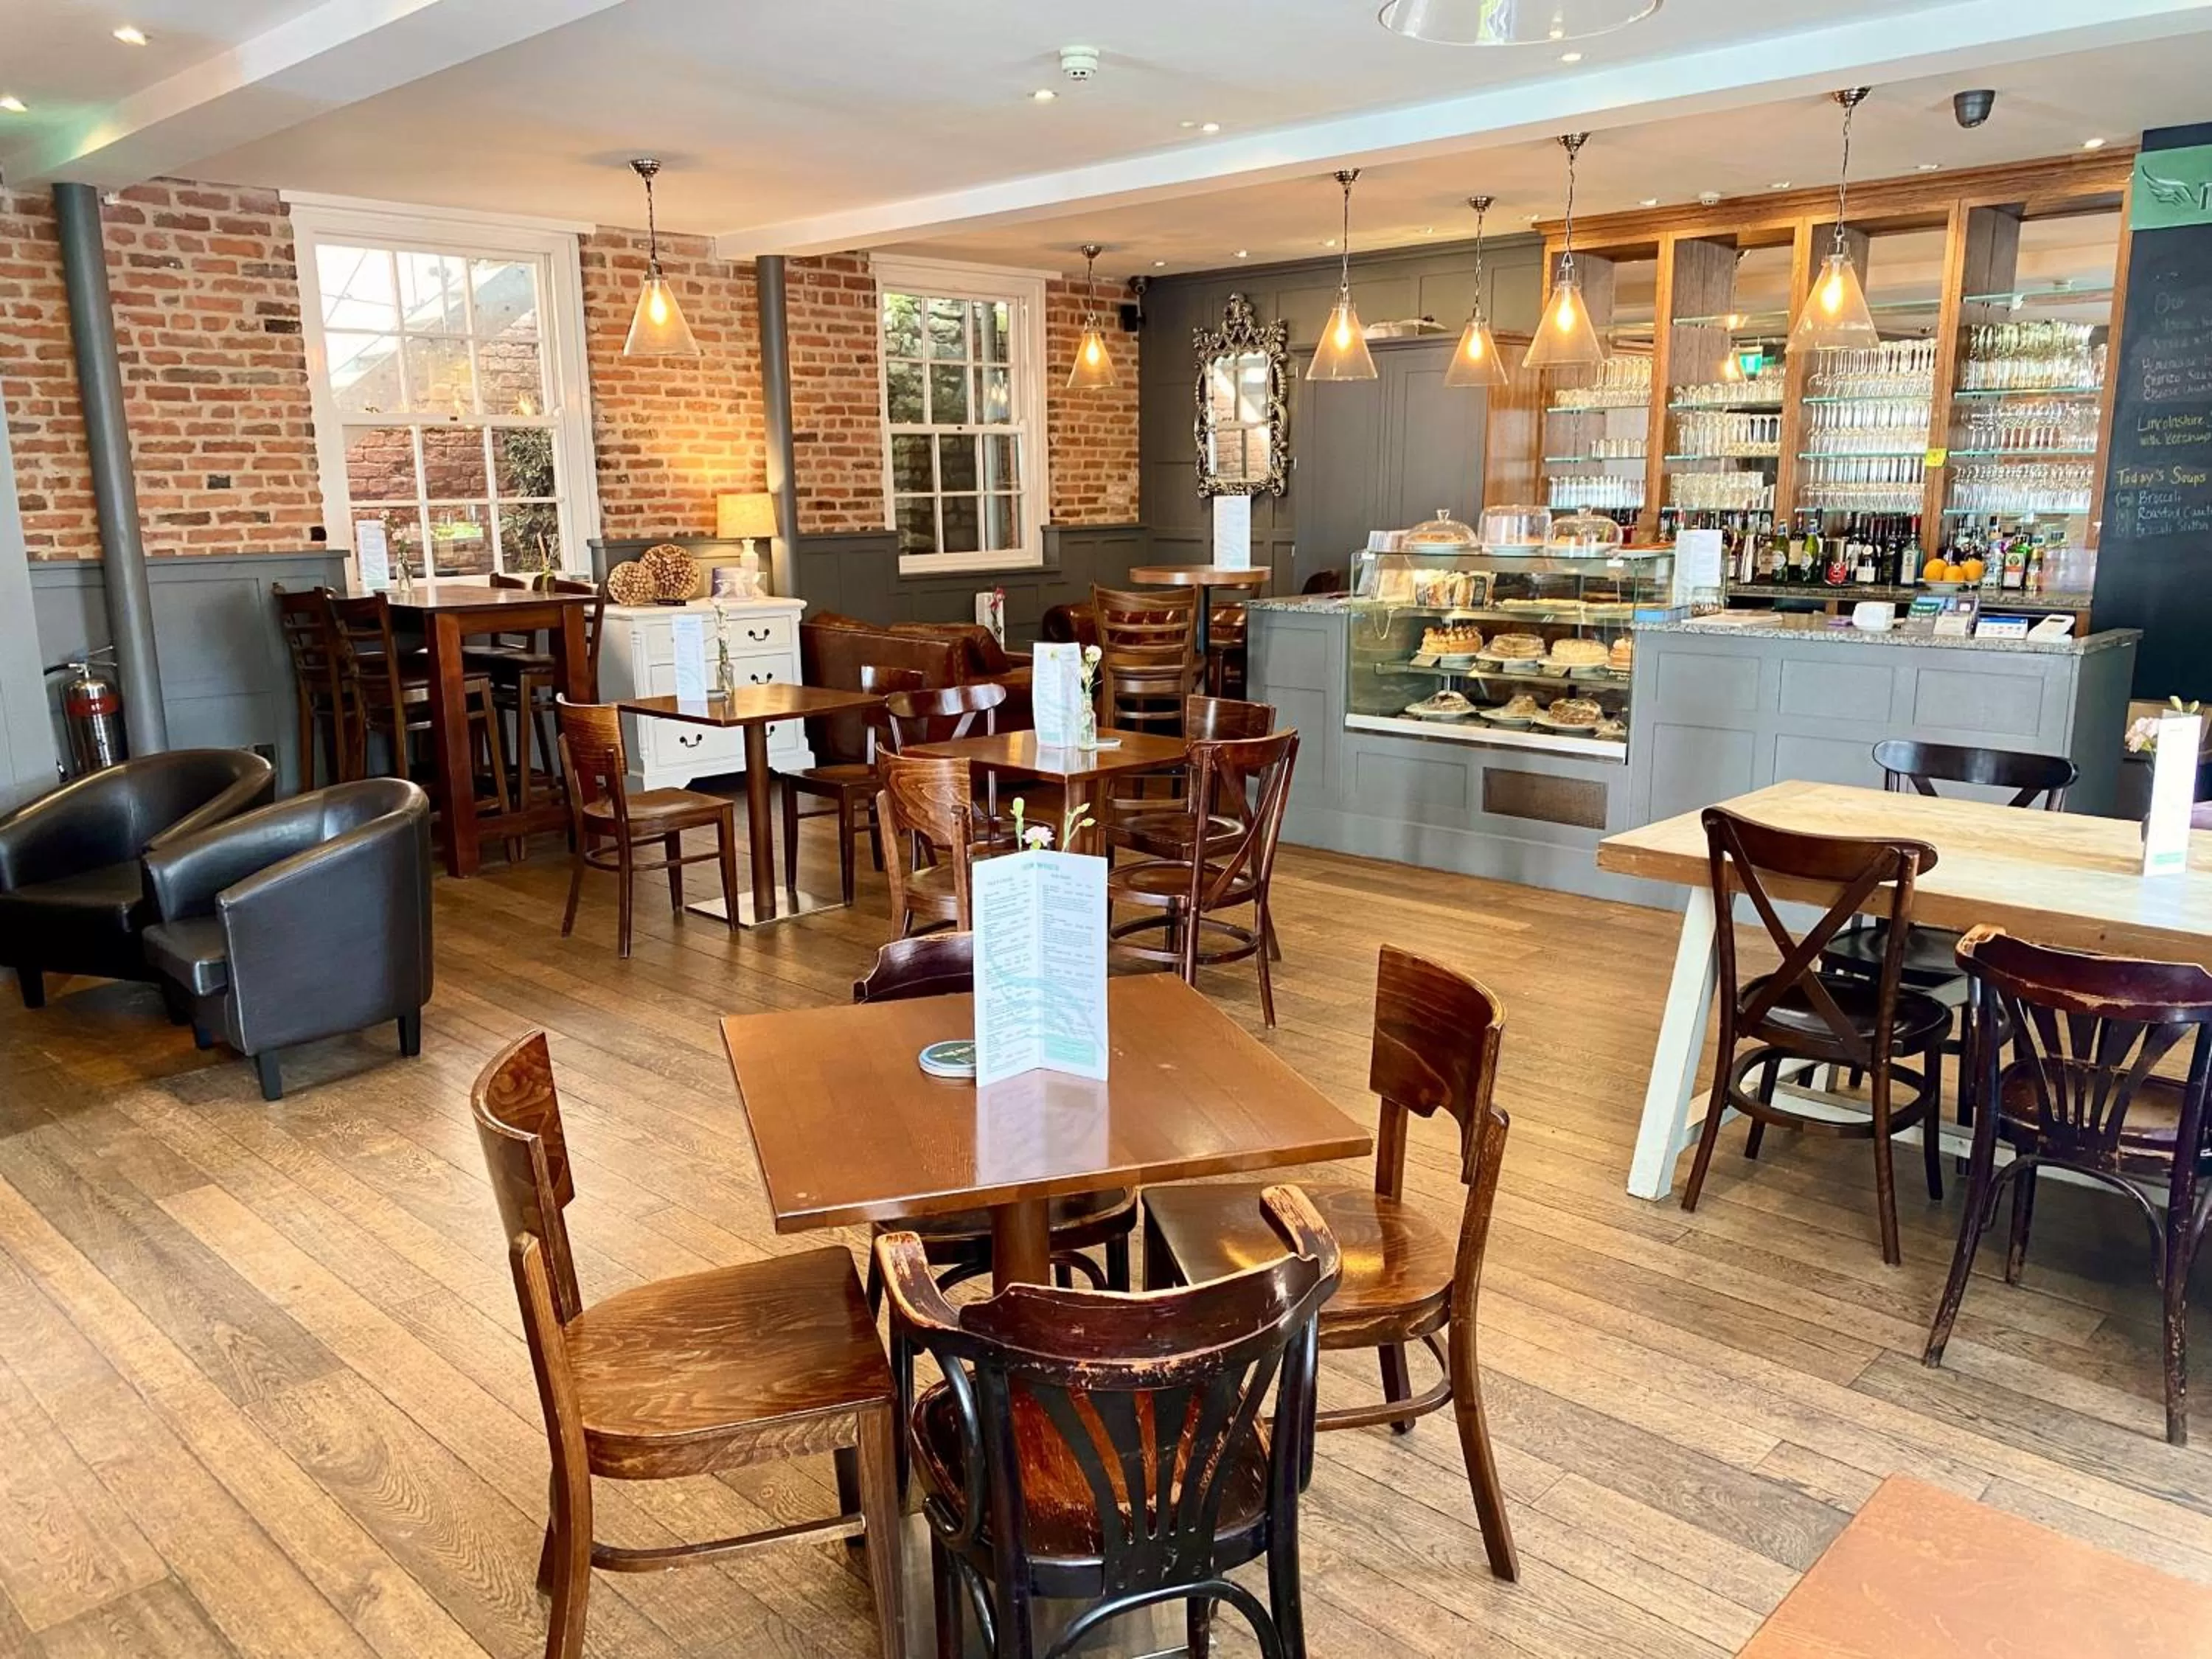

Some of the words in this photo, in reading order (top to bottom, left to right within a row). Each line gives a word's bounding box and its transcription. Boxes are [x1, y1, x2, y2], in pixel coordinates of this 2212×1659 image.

[2138, 414, 2205, 431] Lincolnshire
[2116, 467, 2164, 487] Today's
[2170, 465, 2206, 487] Soups
